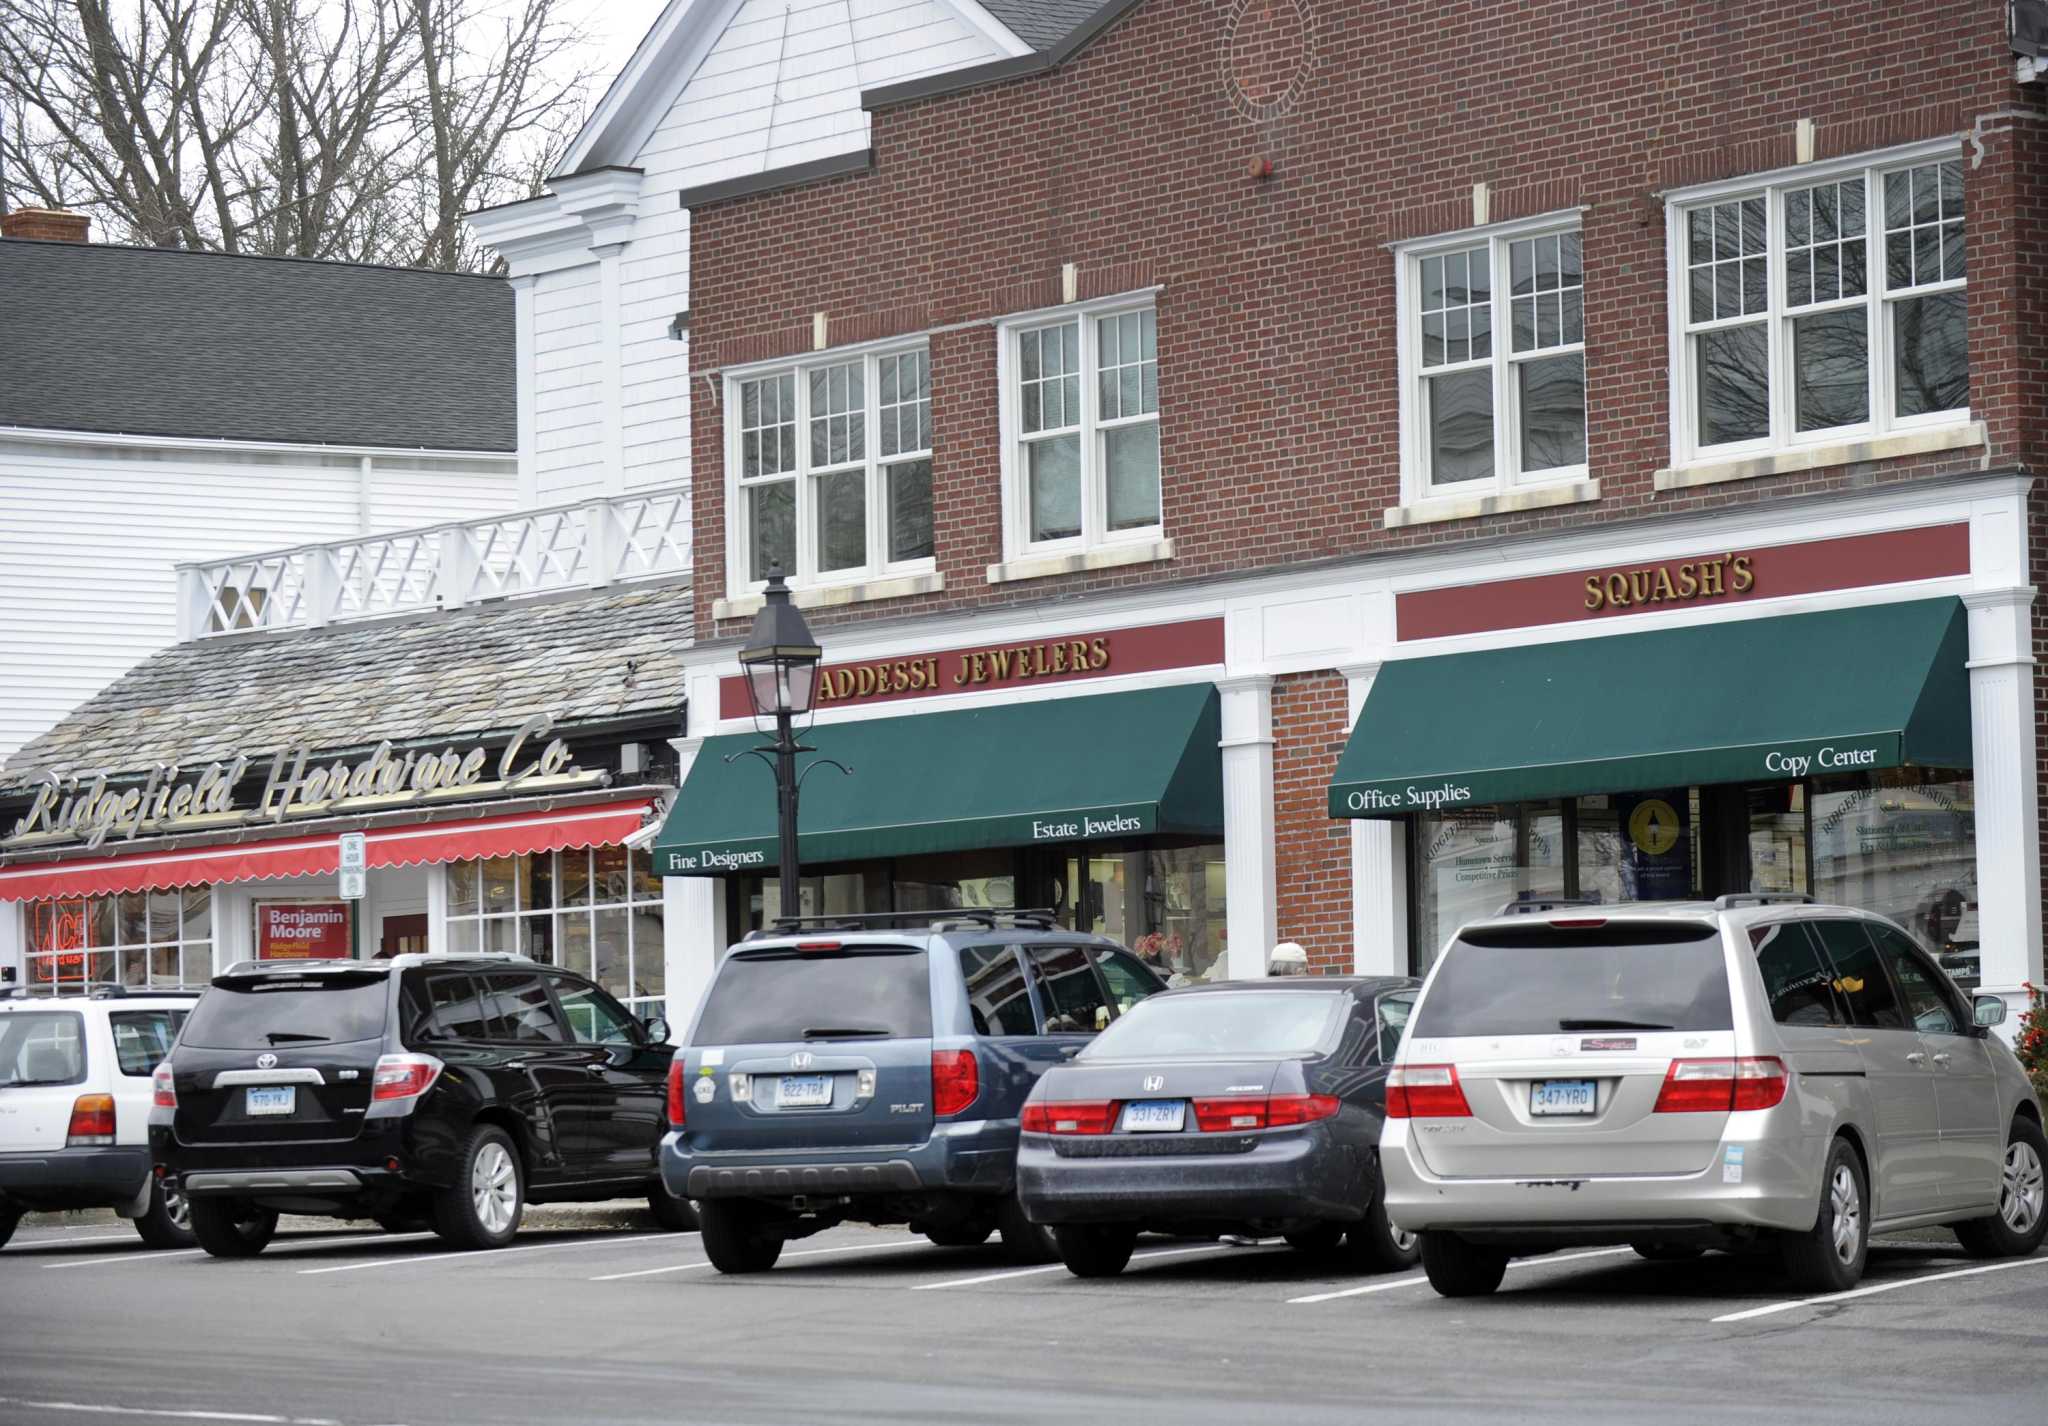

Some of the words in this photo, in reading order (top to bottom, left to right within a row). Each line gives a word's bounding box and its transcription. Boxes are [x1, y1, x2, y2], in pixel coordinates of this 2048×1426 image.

[1584, 552, 1755, 610] SQUASH'S
[817, 658, 937, 700] ADDESSI
[953, 637, 1111, 685] JEWELERS
[1765, 752, 1812, 777] Copy
[1818, 747, 1877, 767] Center
[14, 755, 249, 850] Ridgefield
[255, 740, 487, 824] Hardware
[498, 712, 583, 781] Co.
[1347, 790, 1401, 810] Office
[1406, 784, 1472, 810] Supplies
[1032, 820, 1079, 839] Estate
[1082, 814, 1142, 837] Jewelers
[669, 853, 697, 870] Fine
[702, 849, 765, 871] Designers
[269, 908, 344, 927] Benjamin
[269, 924, 322, 939] Moore
[890, 1103, 925, 1114] PILOT
